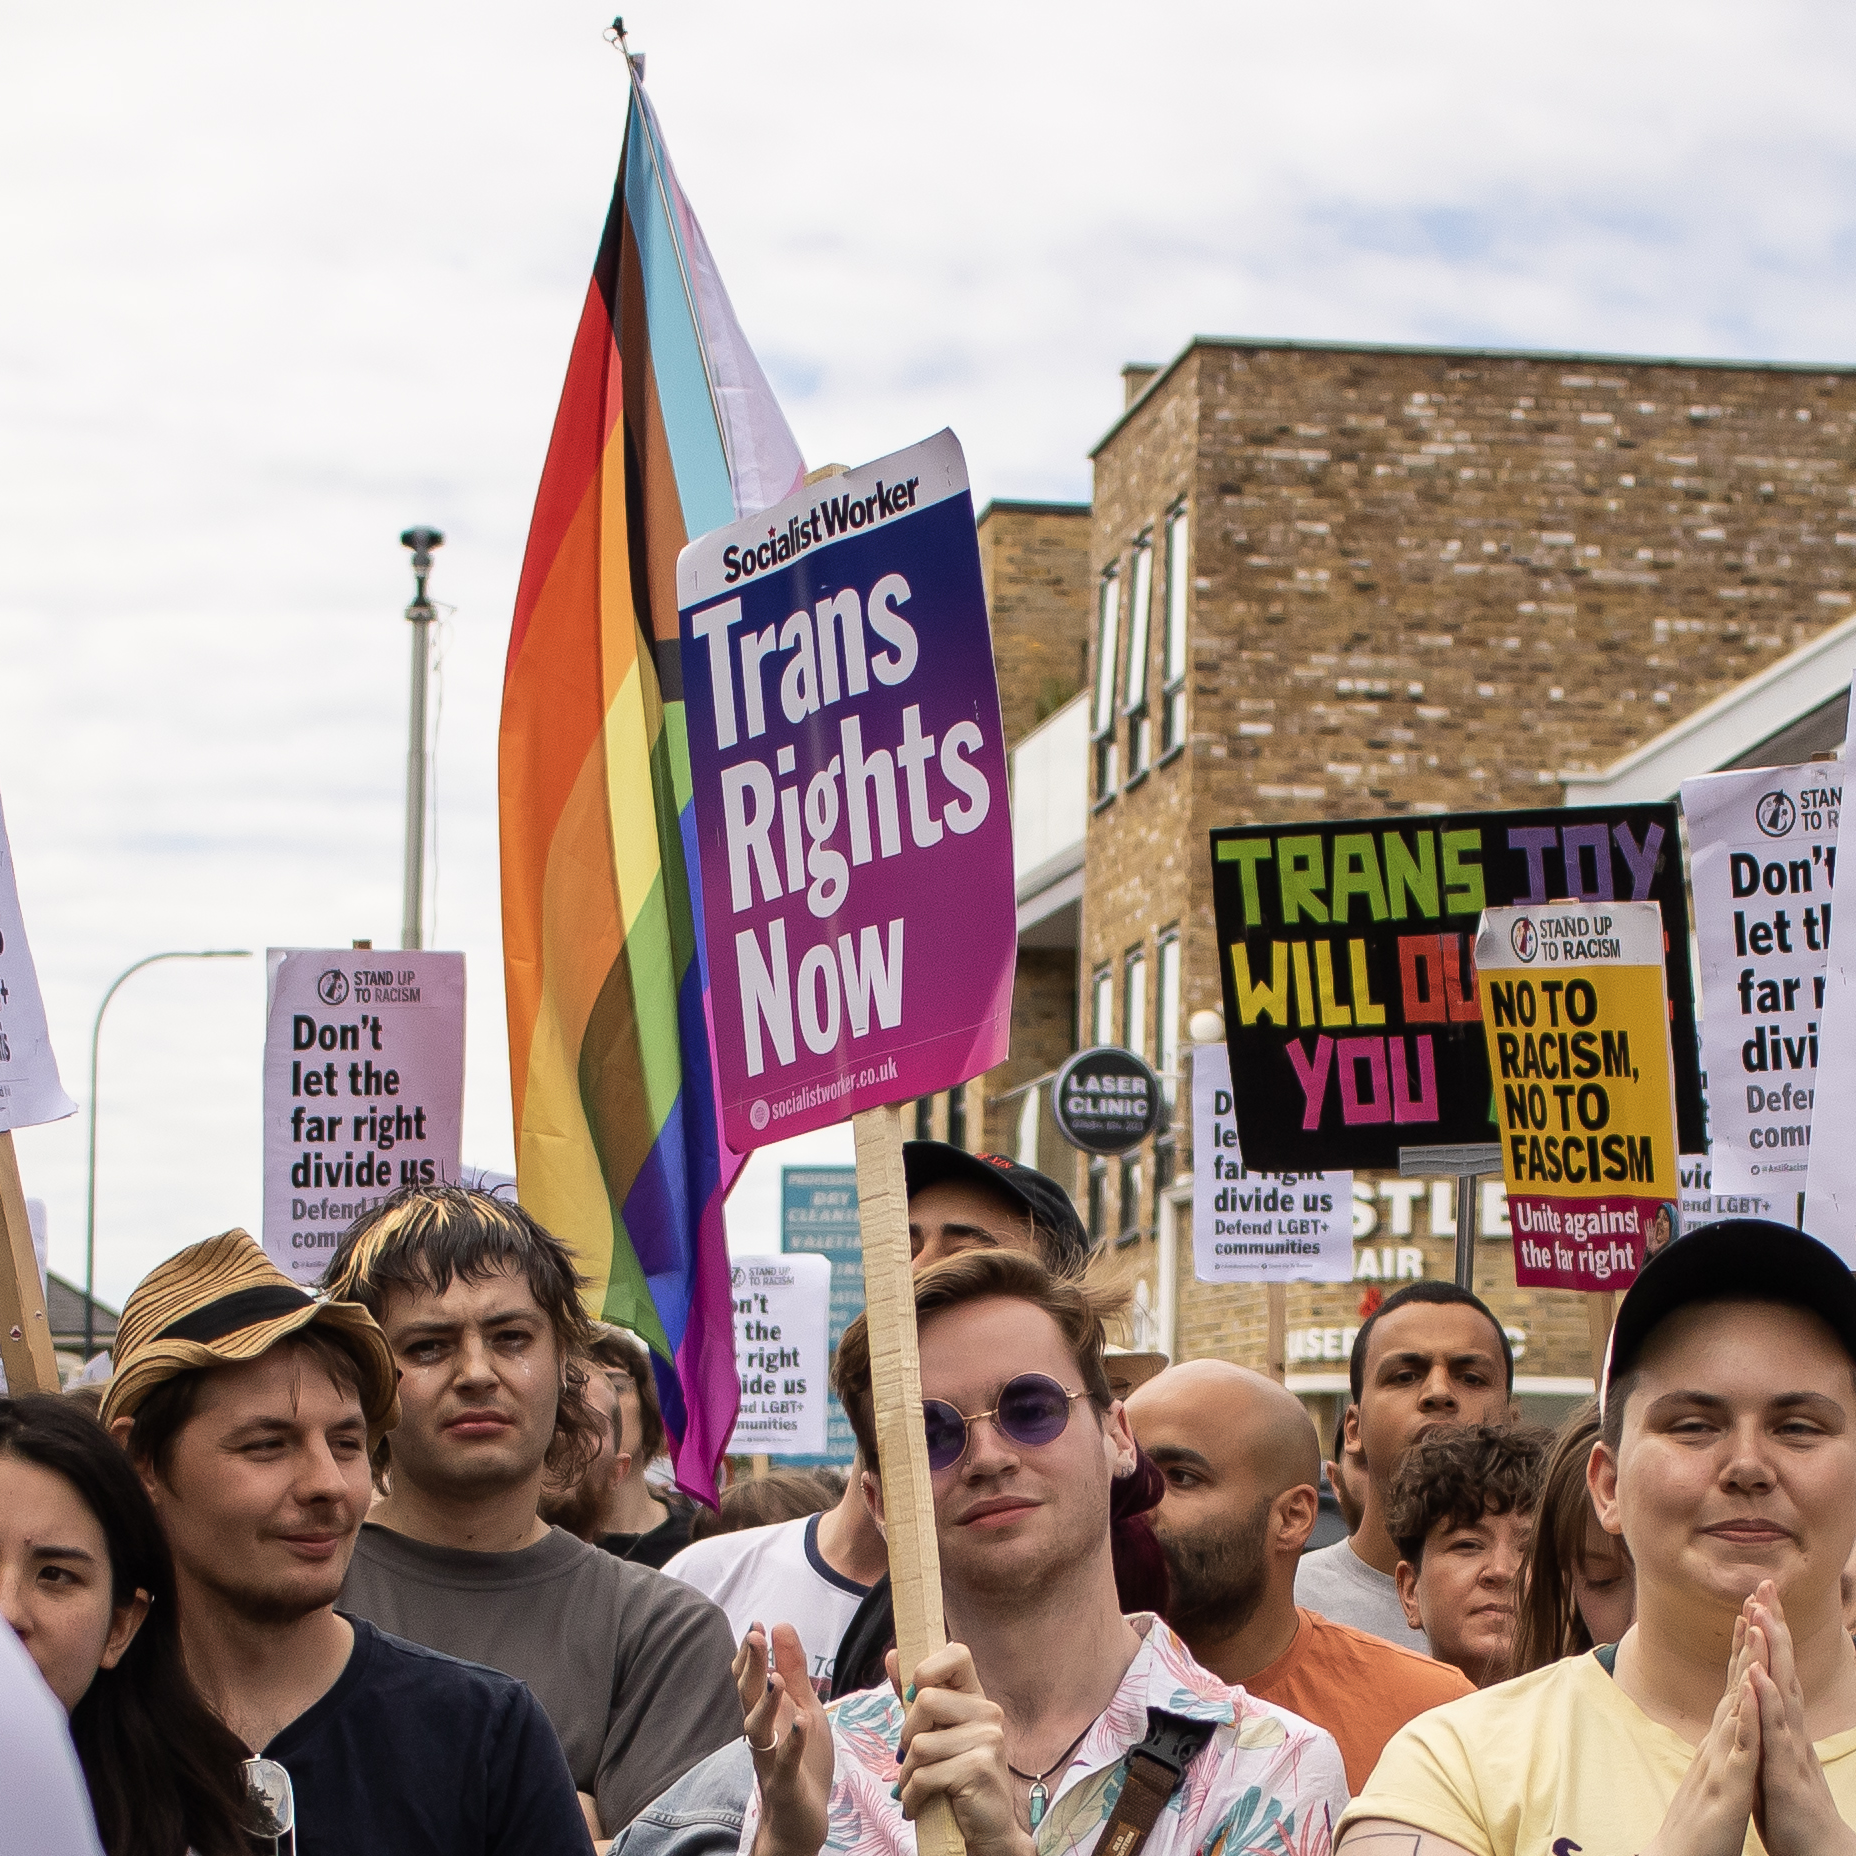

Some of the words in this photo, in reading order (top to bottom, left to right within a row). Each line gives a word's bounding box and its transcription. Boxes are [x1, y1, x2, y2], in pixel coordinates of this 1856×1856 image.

[693, 572, 919, 750] Trans
[720, 704, 990, 918] Rights
[1800, 787, 1842, 809] STAN
[1801, 811, 1822, 831] TO
[1217, 829, 1485, 926] TRANS
[1507, 822, 1665, 906] JOY
[1540, 916, 1589, 938] STAND
[1594, 916, 1612, 936] UP
[1734, 909, 1793, 957] let
[1541, 941, 1559, 961] TO
[1562, 939, 1621, 960] RACISM
[354, 971, 393, 986] STAND
[398, 971, 415, 985] UP
[1231, 938, 1386, 1028] WILL
[1738, 968, 1801, 1015] far
[354, 988, 371, 1003] TO
[375, 987, 421, 1003] RACISM
[734, 917, 905, 1078] Now
[1490, 980, 1536, 1028] NO
[1540, 978, 1598, 1028] TO
[1497, 1030, 1639, 1083] RACISM,
[1742, 1022, 1818, 1072] divi
[292, 1060, 338, 1097] let
[348, 1060, 400, 1096] the
[1069, 1074, 1147, 1094] LASER
[1286, 1033, 1439, 1131] YOU
[1068, 1097, 1148, 1116] CLINIC
[1504, 1083, 1547, 1130] NO
[1553, 1083, 1610, 1131] TO
[1746, 1082, 1814, 1114] Defe
[291, 1105, 343, 1142] far
[353, 1105, 427, 1150] right
[1214, 1122, 1238, 1148] le
[291, 1151, 392, 1188] divide
[400, 1158, 435, 1186] us
[1510, 1134, 1654, 1183] FASCISM
[292, 1197, 366, 1220] Defend
[1214, 1186, 1295, 1212] divide
[1303, 1192, 1334, 1213] us
[1683, 1197, 1711, 1213] end
[1214, 1218, 1273, 1236] Defend
[1277, 1218, 1330, 1235] LGBT+
[1516, 1203, 1561, 1233] Unite
[1565, 1205, 1640, 1242] against
[1214, 1239, 1321, 1256] communities
[1521, 1239, 1551, 1269] the
[1555, 1241, 1573, 1271] far
[1578, 1241, 1635, 1279] right
[749, 1266, 776, 1277] STAND
[750, 1277, 761, 1287] TO
[745, 1320, 782, 1342] the
[747, 1347, 800, 1374] right
[741, 1374, 777, 1395] ide
[784, 1378, 807, 1395] us
[761, 1401, 804, 1414] LGBT+
[737, 1416, 798, 1431] munities
